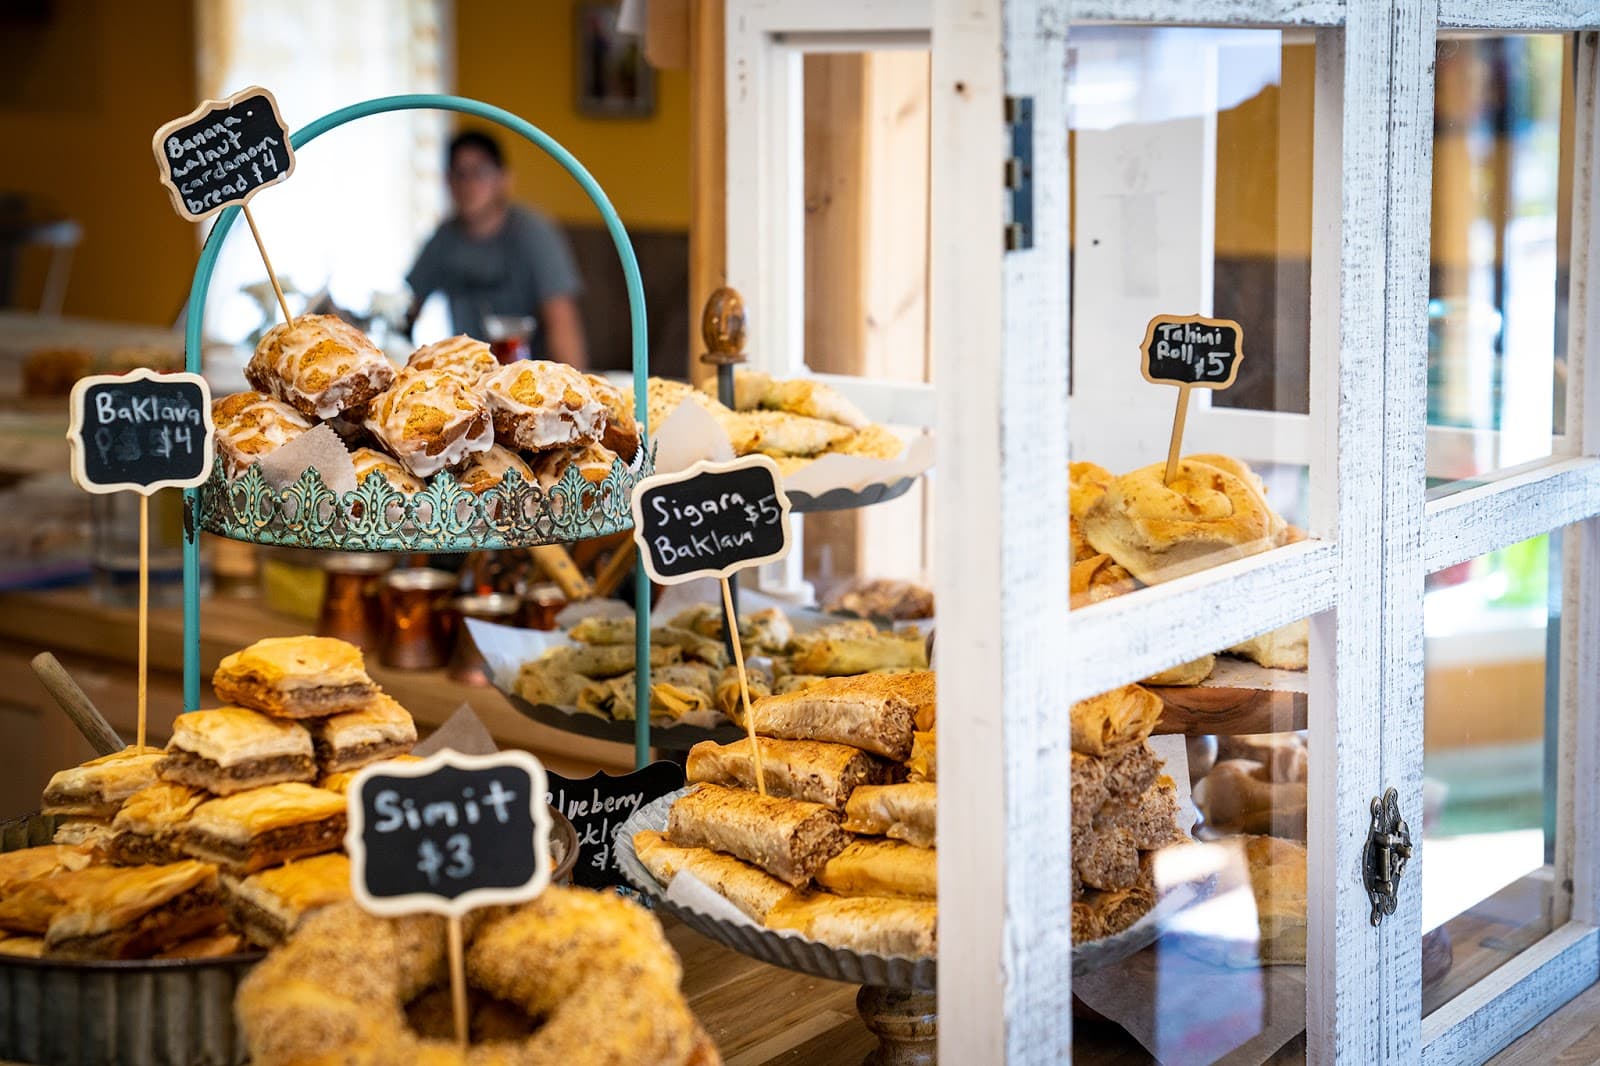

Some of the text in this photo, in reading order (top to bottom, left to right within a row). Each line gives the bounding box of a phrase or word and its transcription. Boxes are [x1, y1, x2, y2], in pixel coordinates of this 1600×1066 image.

[173, 131, 242, 178] walnut
[187, 149, 278, 214] bread $4
[1157, 323, 1222, 346] Tahini
[1156, 340, 1231, 381] Roll $5
[157, 424, 193, 459] $4
[652, 492, 780, 528] Sigara $5
[374, 780, 517, 833] Simit
[545, 787, 644, 821] lueberry
[416, 834, 476, 886] $3
